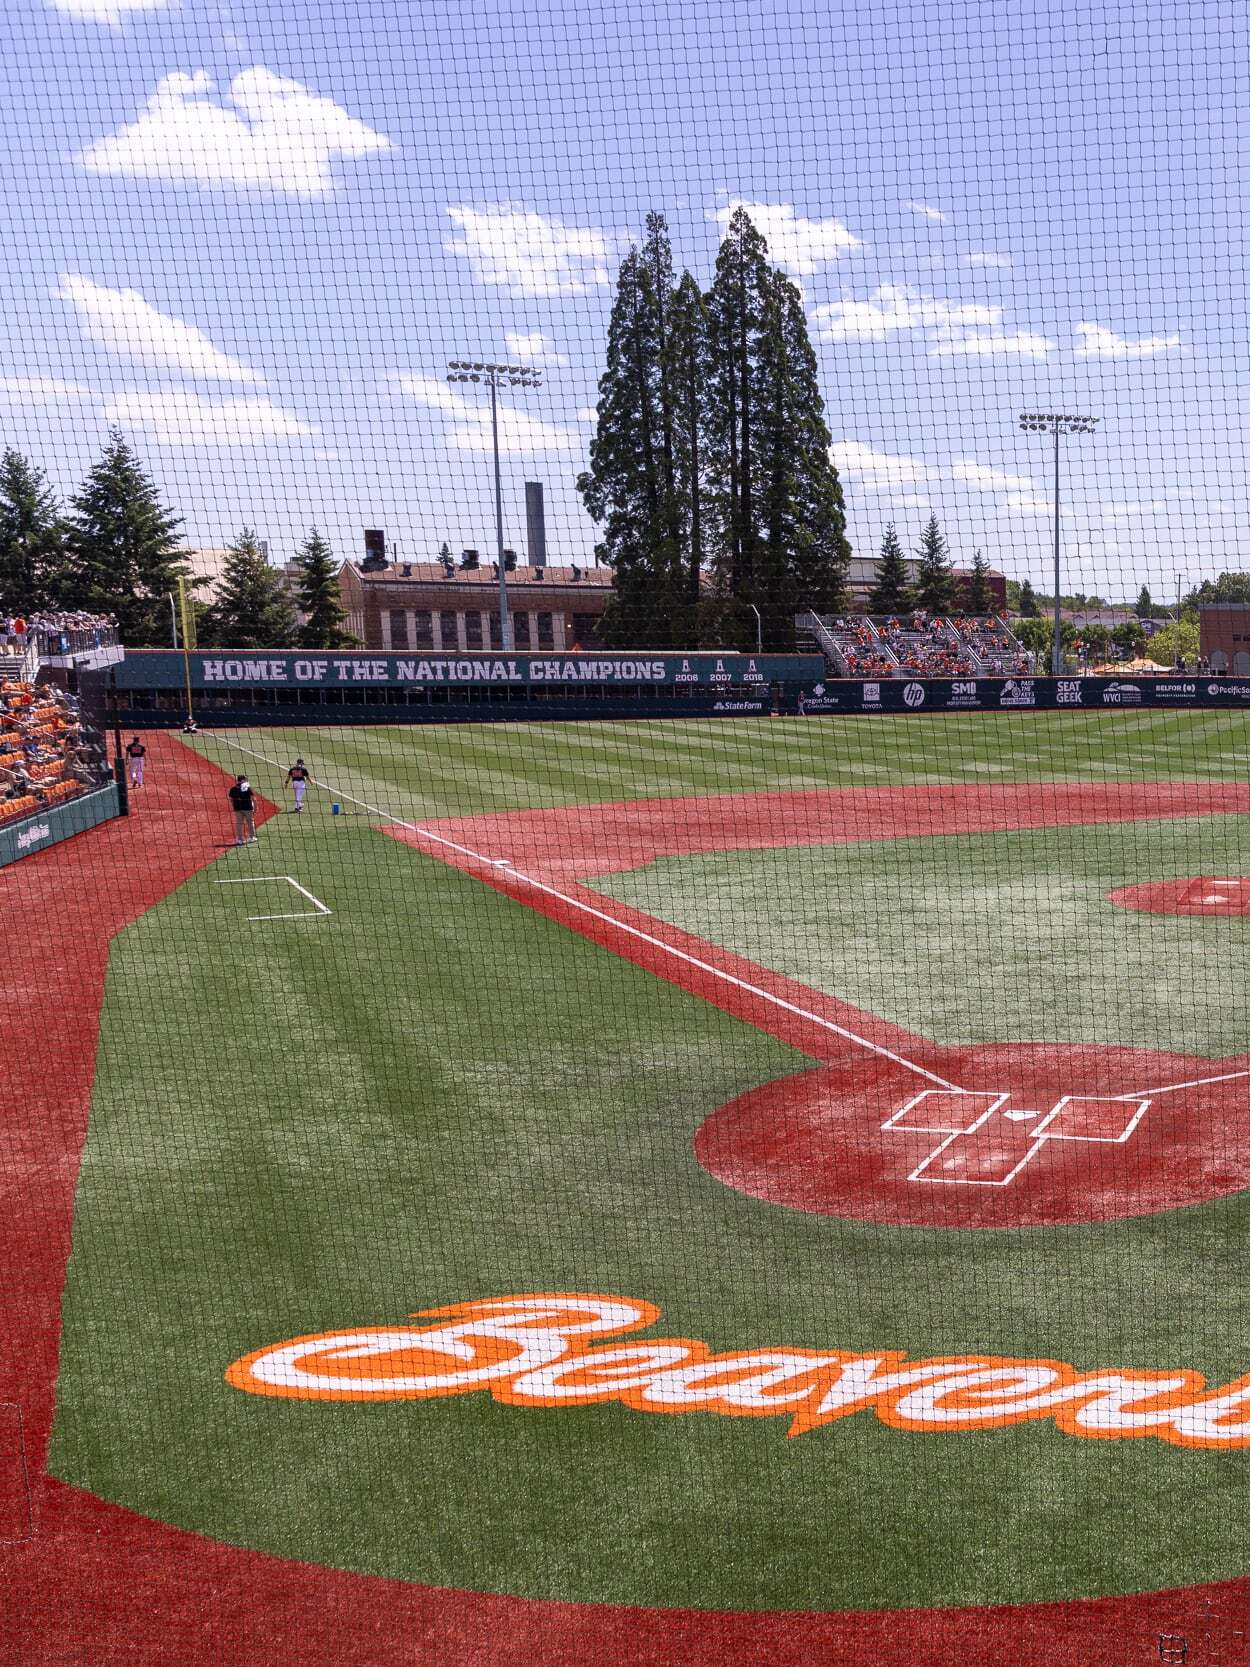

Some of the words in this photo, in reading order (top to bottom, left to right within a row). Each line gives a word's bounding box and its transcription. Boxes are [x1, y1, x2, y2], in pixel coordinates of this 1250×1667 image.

[202, 660, 288, 681] HOME
[294, 660, 328, 681] OF
[333, 660, 389, 681] THE
[396, 660, 522, 681] NATIONAL
[529, 660, 666, 680] CHAMPIONS
[710, 673, 732, 681] 2007
[743, 673, 764, 681] 2018
[1057, 681, 1082, 692] SEAT
[904, 682, 924, 706] hp
[1056, 691, 1083, 703] GEEK
